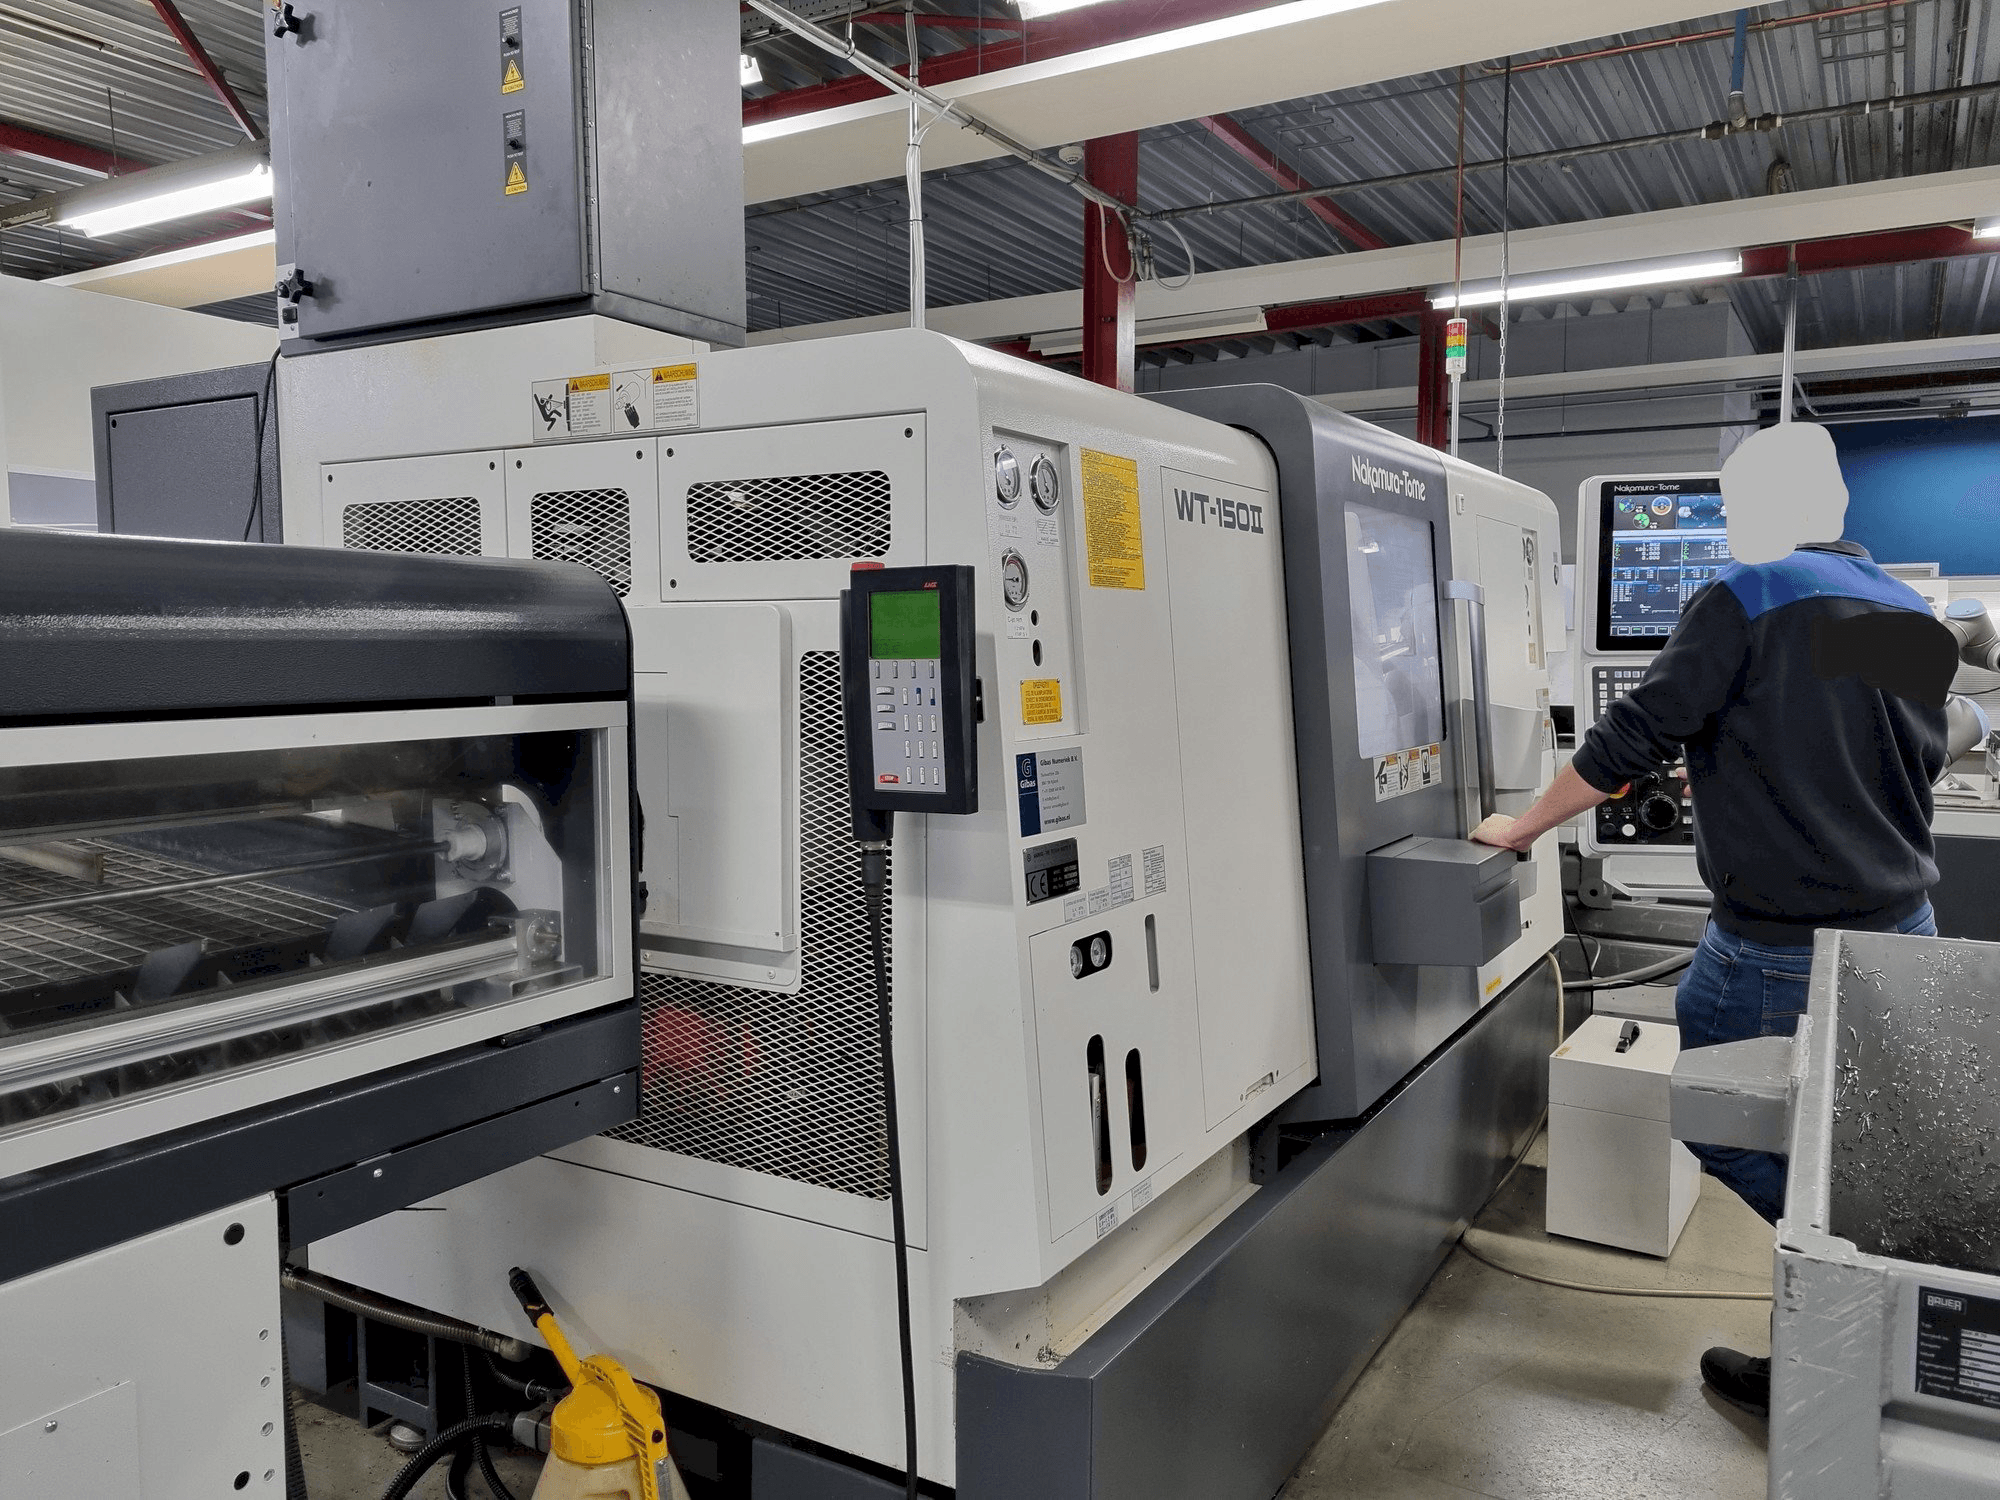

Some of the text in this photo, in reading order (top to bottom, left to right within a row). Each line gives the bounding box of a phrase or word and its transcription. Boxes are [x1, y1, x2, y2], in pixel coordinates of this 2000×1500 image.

[1351, 454, 1426, 502] Nakamura-Tome
[1614, 483, 1680, 493] Nakamura-Tome
[1020, 779, 1036, 789] Gibas
[1030, 873, 1047, 898] CE
[1927, 1295, 1962, 1311] BAUER
